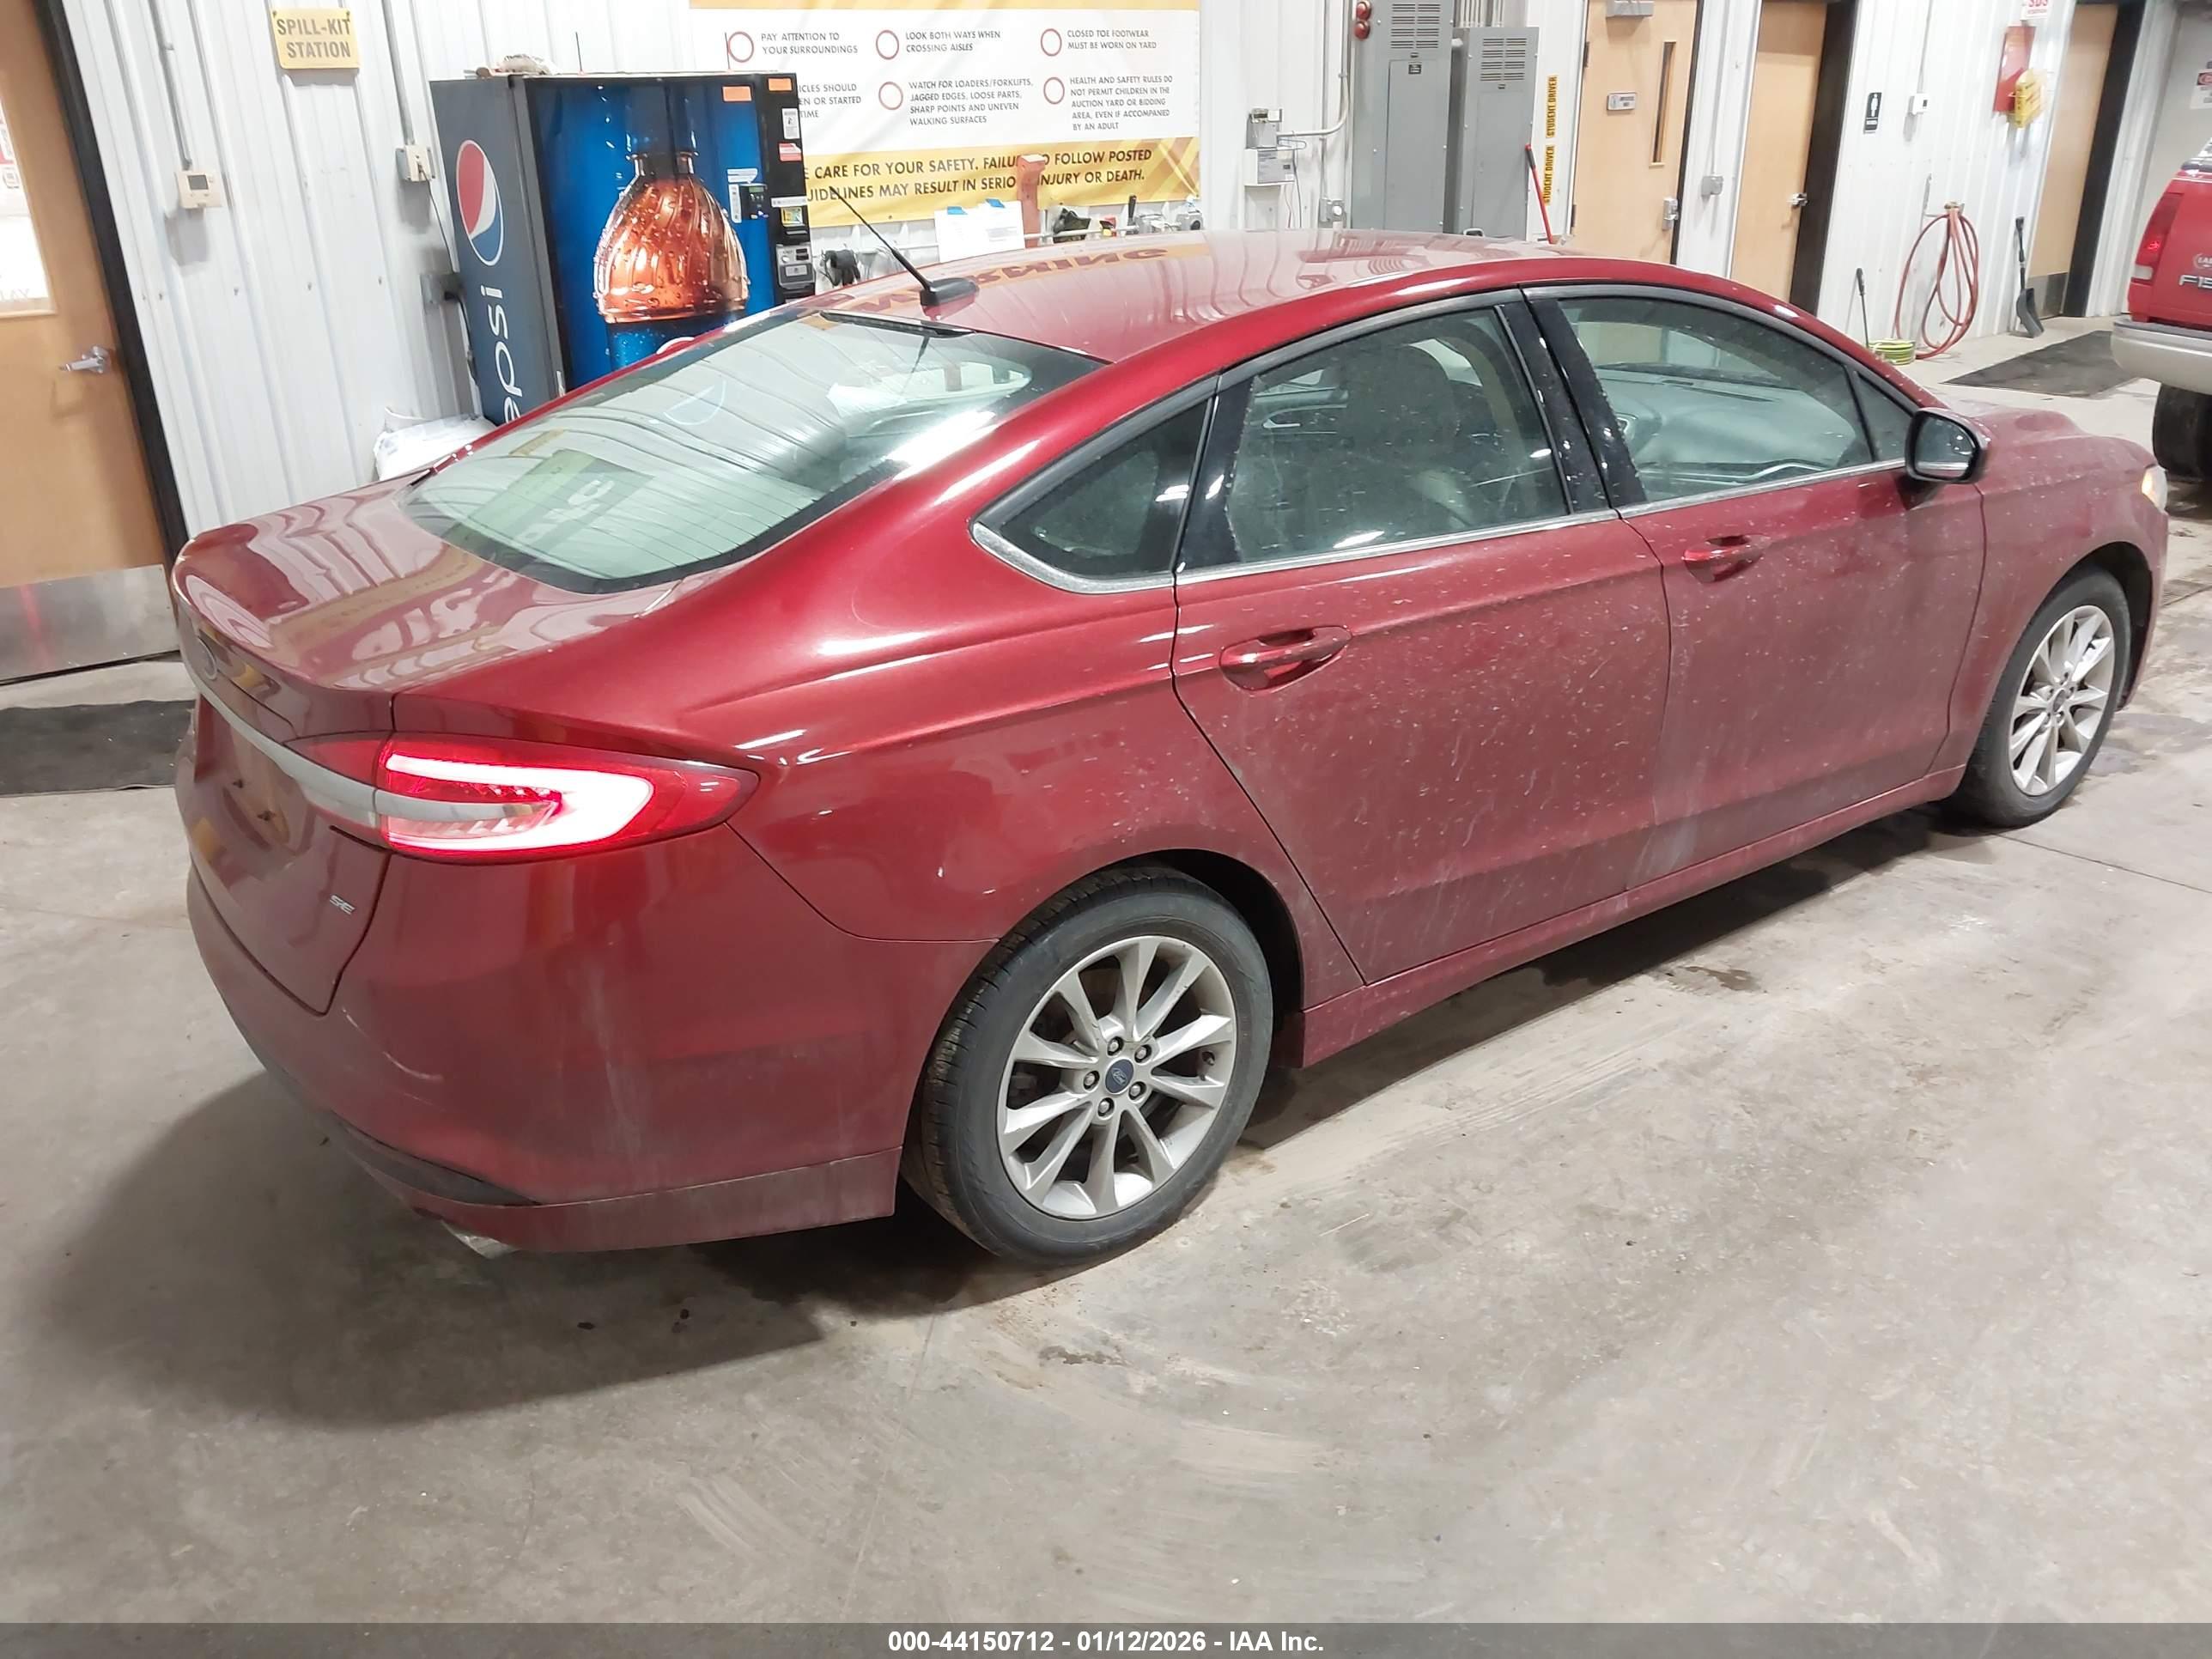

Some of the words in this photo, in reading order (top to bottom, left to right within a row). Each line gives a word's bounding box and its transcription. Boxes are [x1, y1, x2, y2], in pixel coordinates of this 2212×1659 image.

[276, 19, 350, 35] SPILL-KIT
[761, 33, 777, 41] PAY
[781, 33, 825, 41] ATTENTION
[829, 32, 840, 40] TO
[906, 32, 927, 40] LOOK
[929, 31, 951, 40] BOTH
[1097, 29, 1109, 38] TOE
[1111, 29, 1149, 38] FOOTWEAR
[287, 41, 350, 58] STATION
[762, 46, 788, 55] YOUR
[789, 45, 858, 54] SURROUNDINGS
[906, 44, 947, 53] CROSSING
[950, 43, 973, 52] AISLES
[799, 83, 821, 93] ICLES
[823, 83, 857, 93] SHOULD
[908, 81, 936, 89] WATCH
[955, 78, 1034, 88] LOADERS/FORKLIFTS,
[1115, 87, 1148, 95] CHILDREN
[1548, 76, 1557, 103] DRIVER
[813, 96, 826, 105] OR
[829, 96, 861, 105] STARTED
[910, 93, 939, 101] JAGGED
[942, 92, 968, 100] EDGES,
[970, 91, 994, 100] LOOSE
[997, 90, 1023, 99] PARTS,
[910, 105, 934, 113] SHARP
[938, 104, 966, 112] POINTS
[1072, 100, 1103, 108] AUCTION
[1105, 99, 1124, 107] YARD
[909, 117, 947, 125] WALKING
[950, 115, 987, 125] SURFACES
[1072, 112, 1092, 120] AREA,
[1547, 104, 1556, 137] STUDENT
[1073, 123, 1081, 131] BY
[1546, 146, 1554, 171] DRIVER
[816, 165, 848, 179] CARE
[854, 162, 880, 177] FOR
[885, 161, 924, 175] YOUR
[929, 158, 979, 173] SAFETY.
[983, 155, 1019, 169] FAILU
[1042, 154, 1050, 165] O
[1054, 151, 1105, 165] FOLLOW
[1109, 149, 1152, 163] POSTED
[807, 185, 874, 202] UIDELINES
[879, 183, 909, 198] MAY
[915, 179, 959, 195] RESULT
[963, 178, 976, 191] IN
[981, 176, 1016, 191] SERIO
[1036, 172, 1081, 186] INJURY
[1085, 171, 1103, 183] OR
[1107, 169, 1146, 183] DEATH.
[480, 284, 523, 424] epsi
[329, 895, 356, 915] SE
